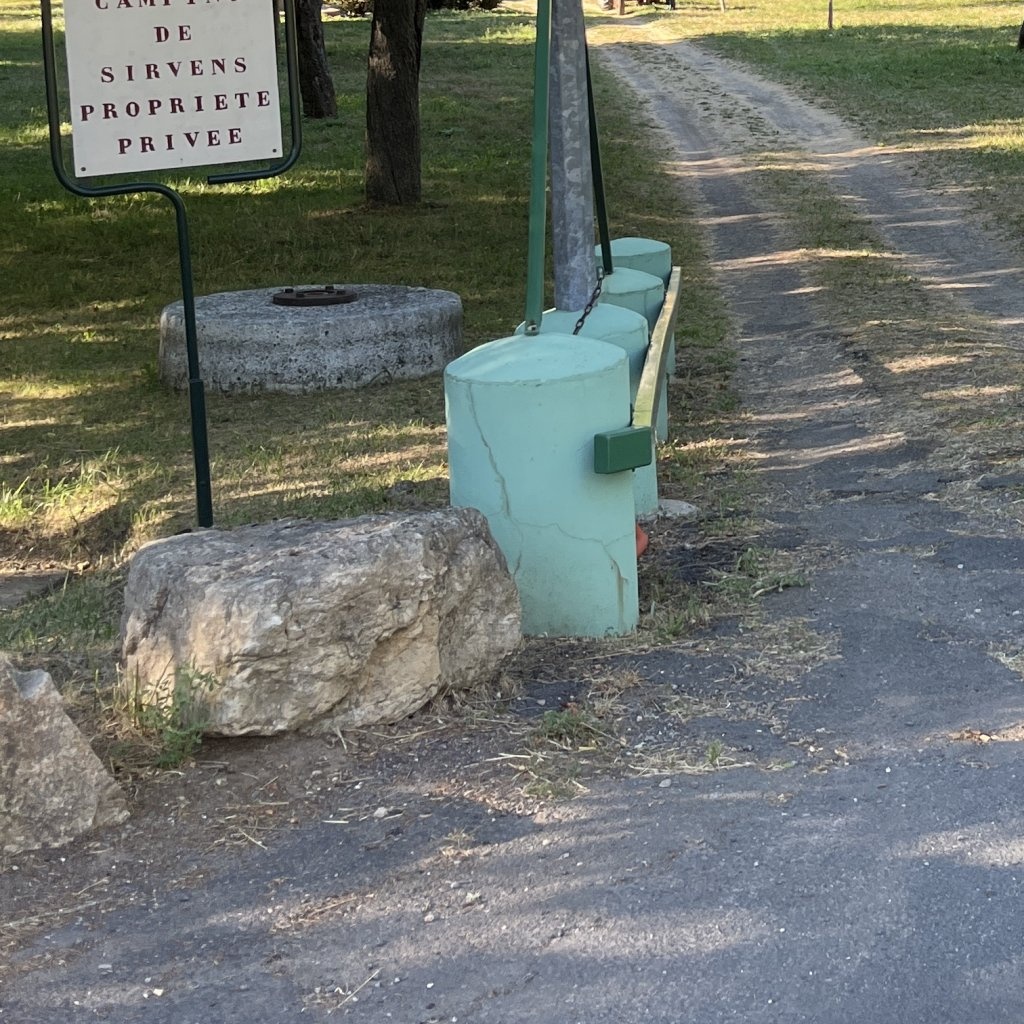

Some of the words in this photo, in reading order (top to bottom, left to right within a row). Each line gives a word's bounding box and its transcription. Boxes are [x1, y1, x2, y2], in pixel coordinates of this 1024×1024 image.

[154, 25, 192, 43] DE
[100, 57, 247, 83] SIRVENS
[80, 90, 271, 122] PROPRIETE
[117, 128, 243, 155] PRIVEE
